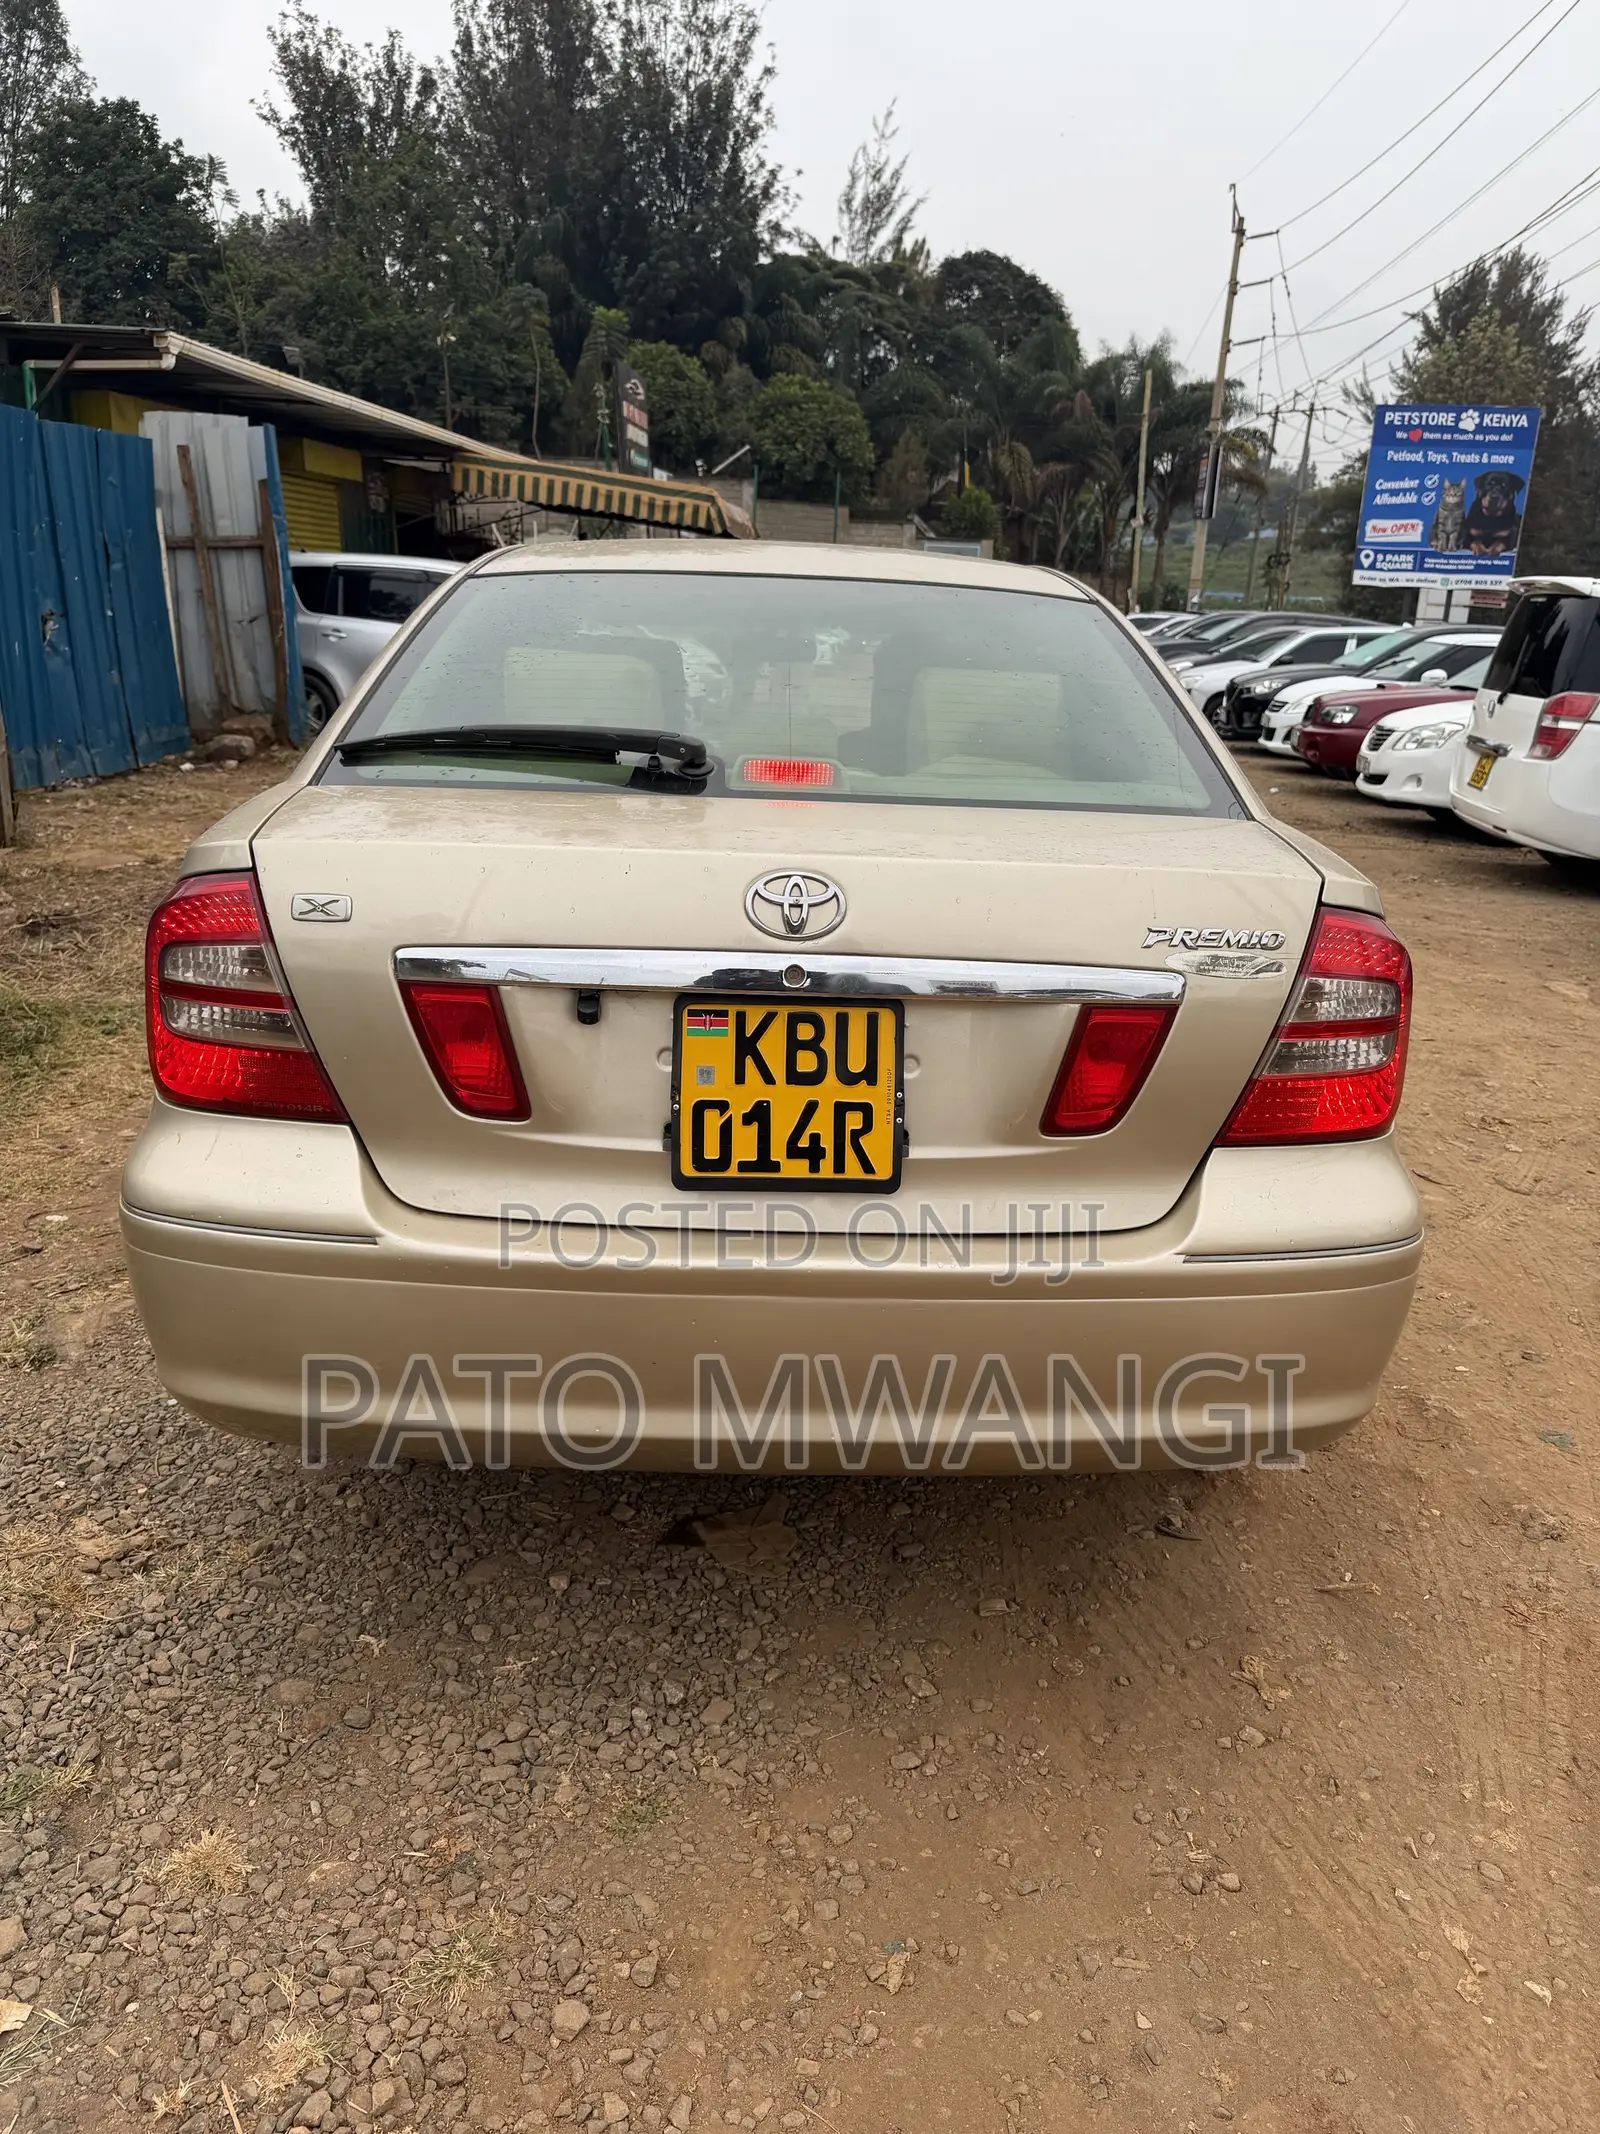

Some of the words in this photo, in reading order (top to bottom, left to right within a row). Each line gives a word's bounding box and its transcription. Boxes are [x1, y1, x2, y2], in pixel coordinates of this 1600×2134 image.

[1384, 411, 1457, 426] PETSTORE
[1482, 413, 1529, 427] KENYA
[1395, 430, 1408, 439] We
[1423, 431, 1442, 440] them
[1442, 432, 1452, 440] as
[1453, 432, 1474, 440] much
[1484, 433, 1499, 442] you
[1500, 433, 1514, 441] do!
[1387, 450, 1424, 463] Petfood,
[1427, 451, 1449, 464] Toys,
[1452, 451, 1480, 463] Treats
[1481, 452, 1489, 463] &
[1490, 454, 1515, 464] more
[1373, 491, 1418, 505] Affordable
[1370, 524, 1388, 534] Now
[1376, 553, 1384, 562] 9
[1385, 554, 1415, 562] PARK
[1375, 561, 1414, 570] SQUARE
[1141, 927, 1286, 950] PREMIO
[734, 1010, 880, 1087] KBU
[691, 1099, 876, 1174] 014R
